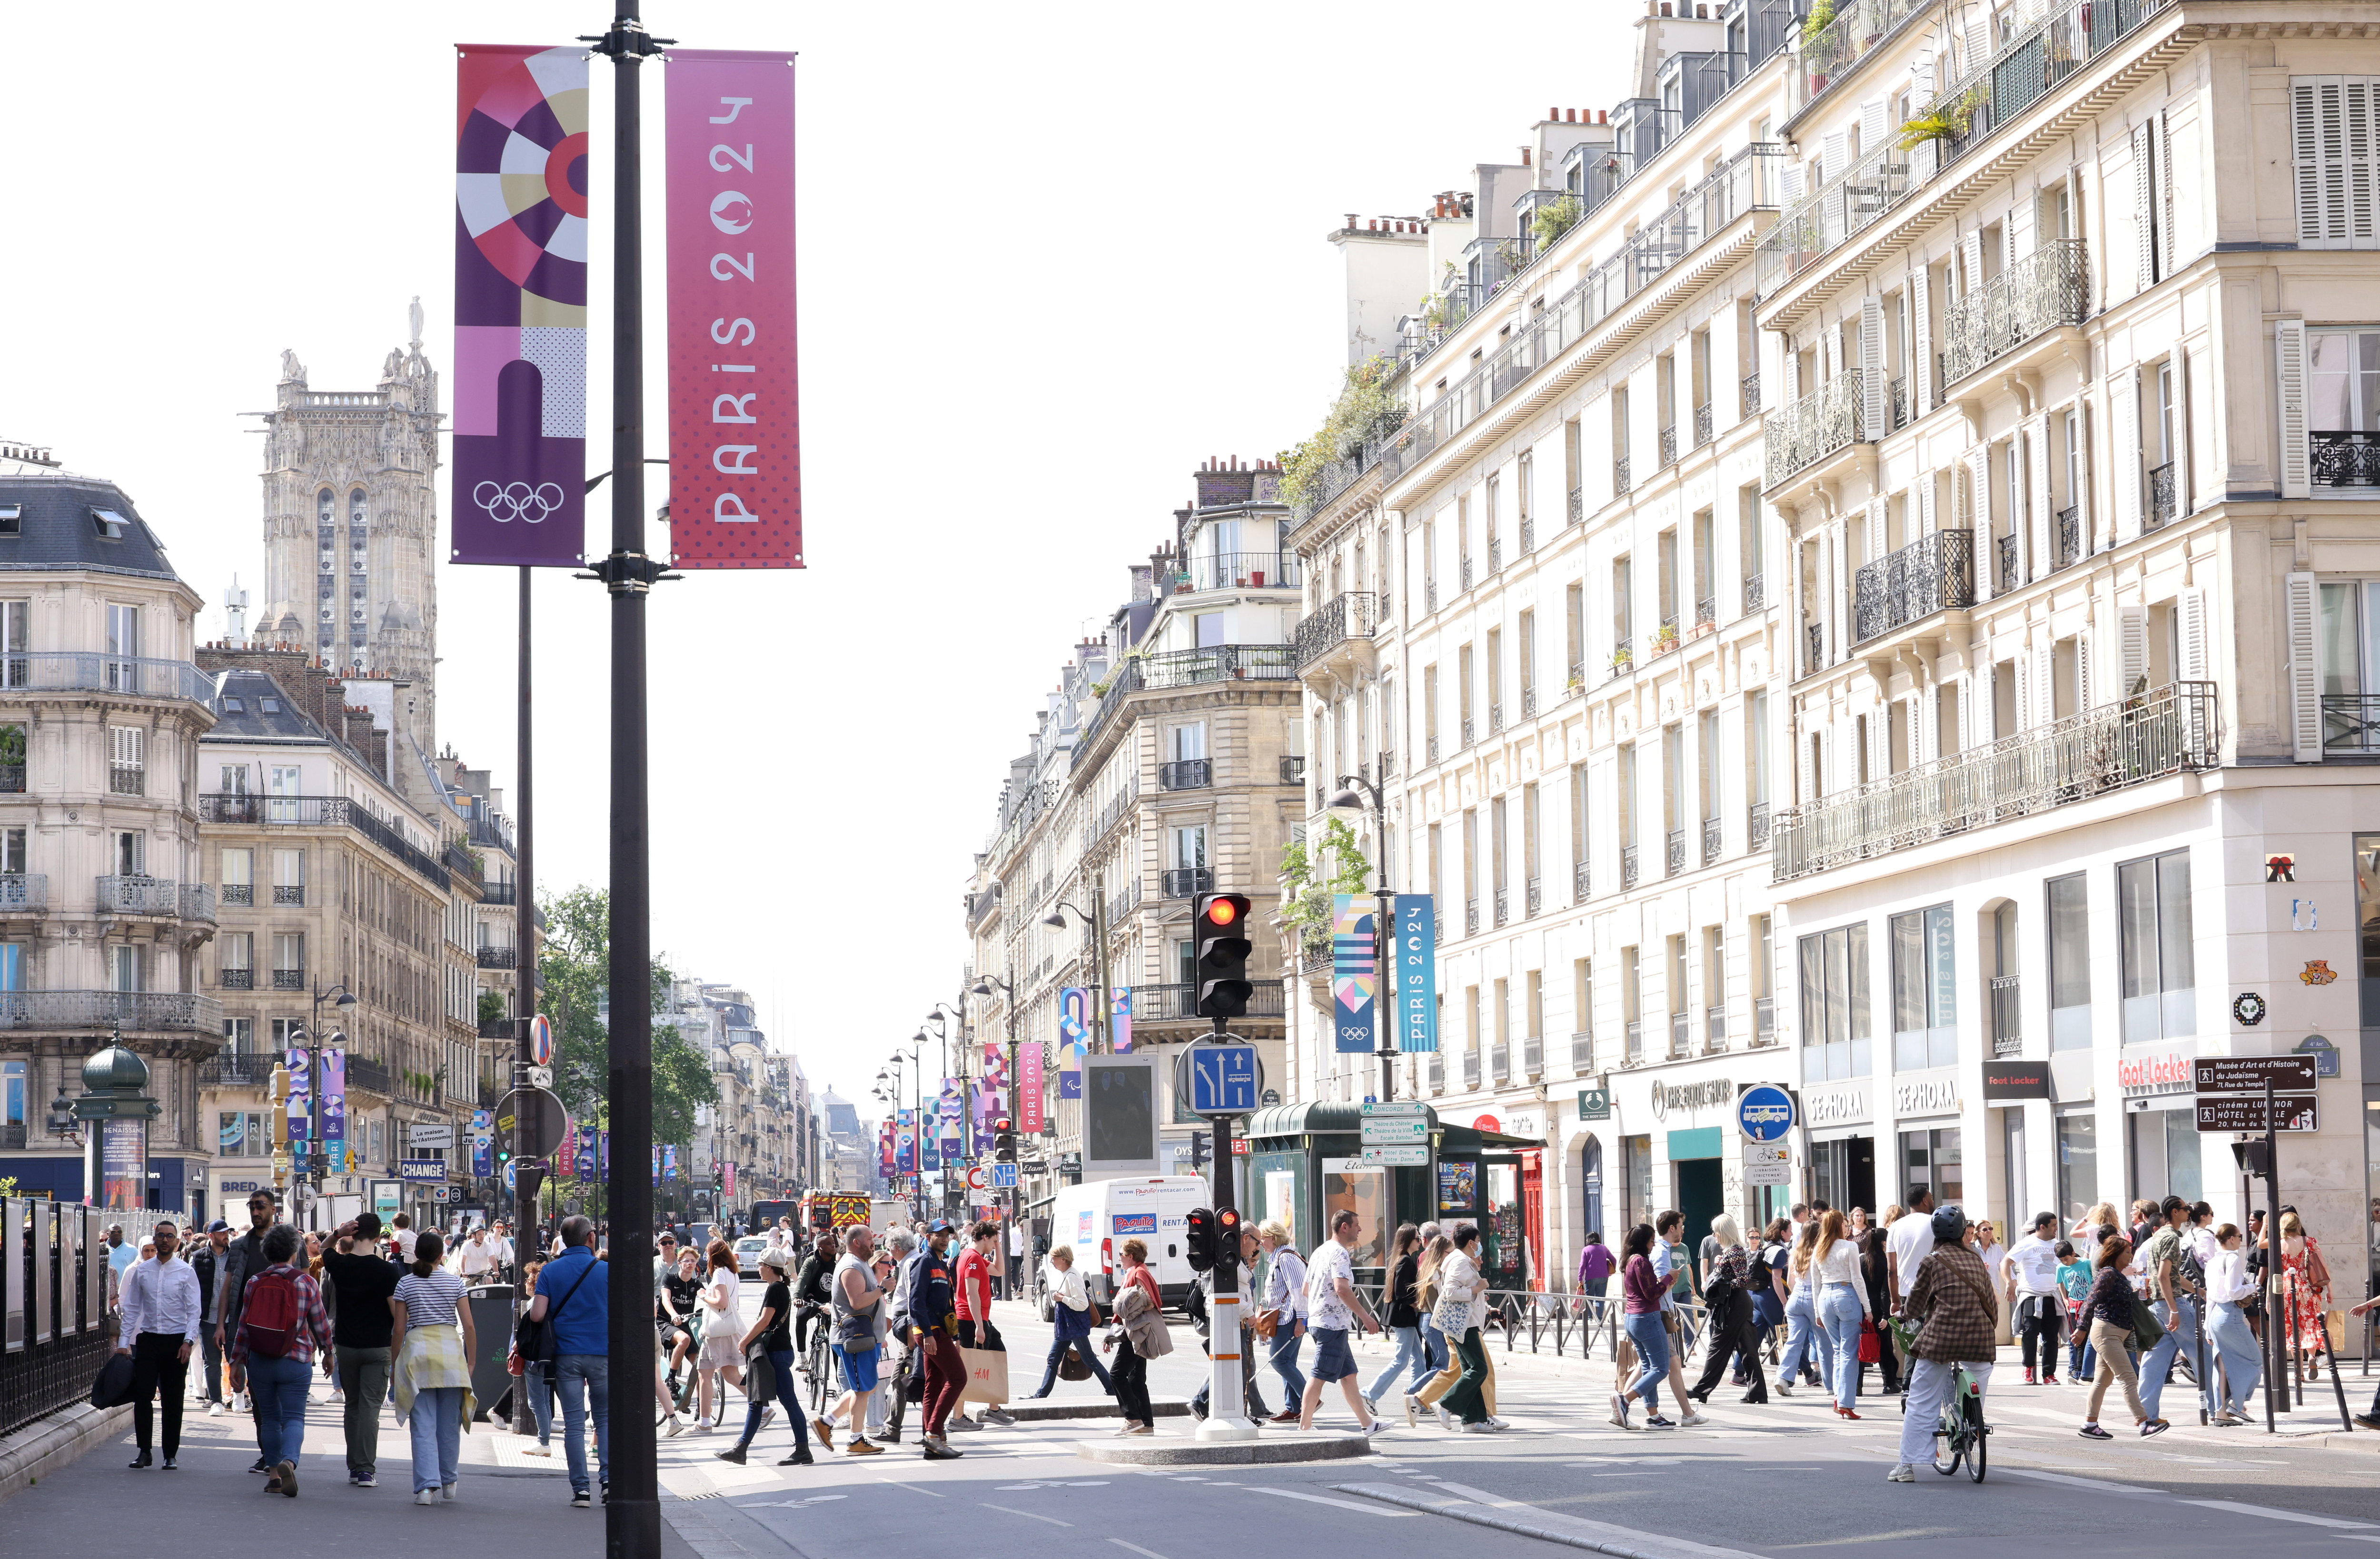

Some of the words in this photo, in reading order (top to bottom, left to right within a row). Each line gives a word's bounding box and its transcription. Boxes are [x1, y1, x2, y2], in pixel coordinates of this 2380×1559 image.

[709, 97, 754, 282] 2024
[1408, 908, 1422, 965] 2024
[1026, 1050, 1036, 1083] 2024
[2119, 1058, 2144, 1087] Foot
[2148, 1054, 2191, 1085] Locker
[1989, 1076, 2008, 1085] Foot
[2010, 1076, 2040, 1085] Locker
[1666, 1085, 1681, 1108] THE
[1683, 1082, 1706, 1107] BODY
[1706, 1078, 1731, 1104] SHOP
[1895, 1080, 1954, 1112] SEPHORA
[1810, 1090, 1863, 1121] SEPHORA
[2217, 1110, 2244, 1118] HÔTEL
[234, 1122, 272, 1133] BRE
[418, 1135, 451, 1143] l'Astronomie
[402, 1164, 443, 1177] CHANGE
[105, 1181, 136, 1195] PASSE
[221, 1182, 258, 1192] BRED
[974, 1367, 990, 1381] H&M
